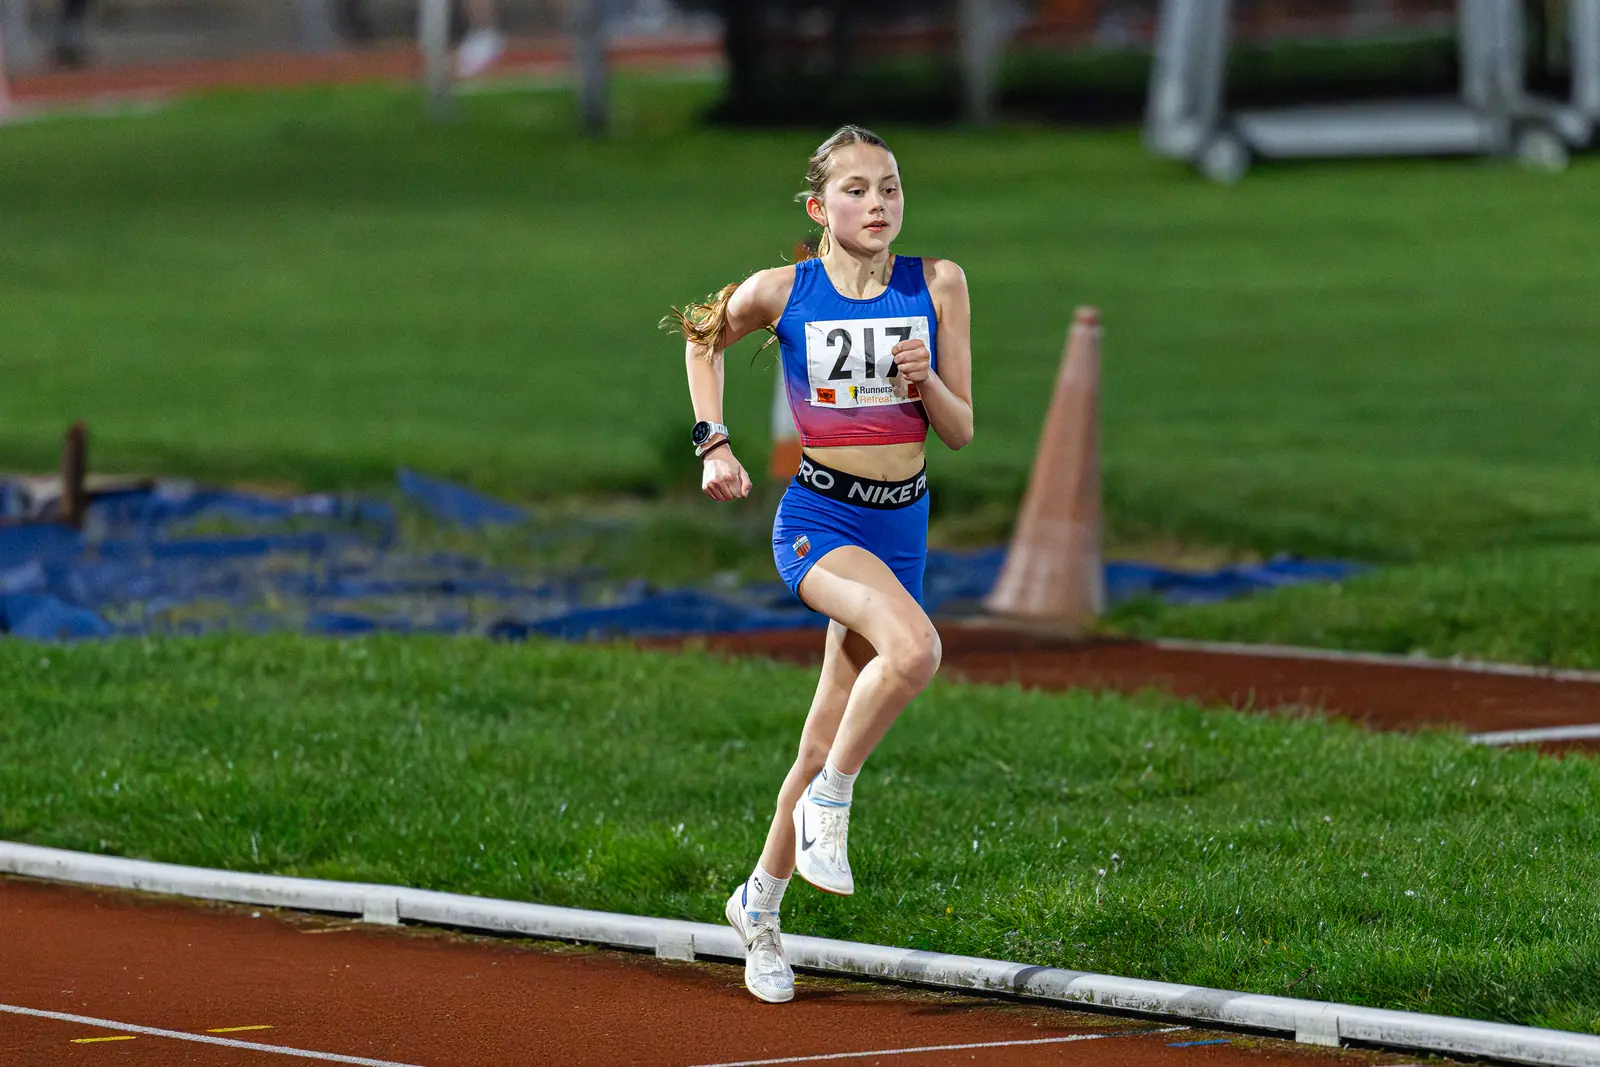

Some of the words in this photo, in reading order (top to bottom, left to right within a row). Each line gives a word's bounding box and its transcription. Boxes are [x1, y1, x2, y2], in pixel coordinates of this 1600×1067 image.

[826, 326, 912, 381] 217
[860, 394, 893, 404] Retreat
[798, 456, 835, 490] RO
[847, 481, 914, 504] NIKE
